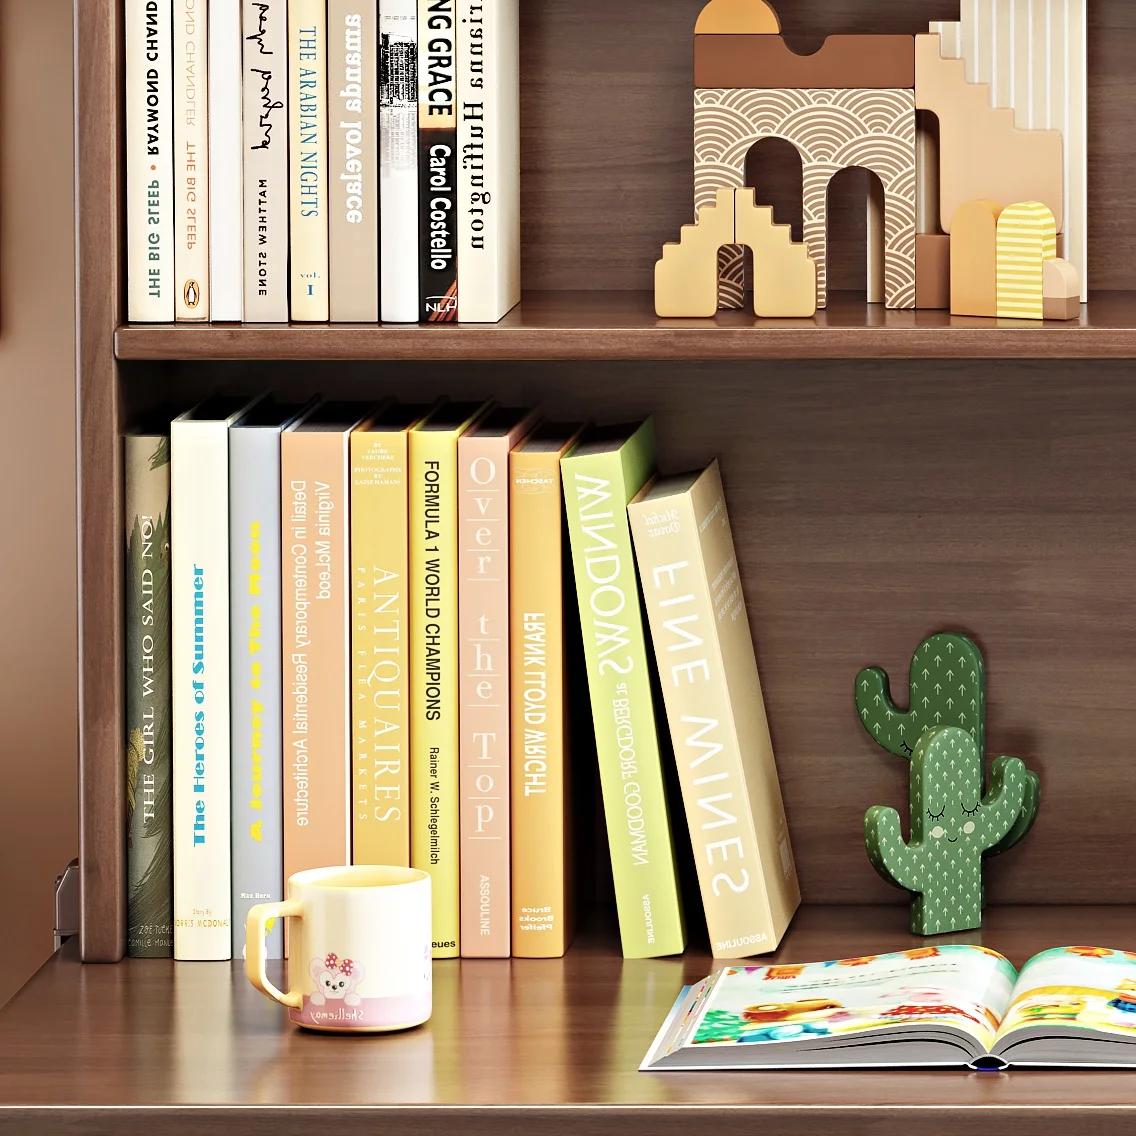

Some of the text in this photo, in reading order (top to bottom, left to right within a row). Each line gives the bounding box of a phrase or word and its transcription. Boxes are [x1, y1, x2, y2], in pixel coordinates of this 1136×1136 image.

[299, 26, 319, 217] THE ARABIAN NIGHTS
[427, 37, 453, 116] GRACE
[429, 144, 452, 270] Carol Costello
[300, 271, 321, 279] vol.
[424, 461, 440, 541] FORMULA
[424, 558, 441, 619] WORLD
[141, 515, 155, 824] THE GIRL WHO SAID NO!
[192, 563, 206, 848] The Heroes of Summer
[247, 521, 265, 843] A Journey to The Moon
[357, 567, 368, 821] PARIS FLEA MARKETS
[366, 565, 401, 822] ANTIQUAIRES
[425, 623, 441, 721] CHAMPIONS
[427, 747, 440, 865] Rainer W. Schlegelmilch
[479, 874, 491, 936] ASSOULINE
